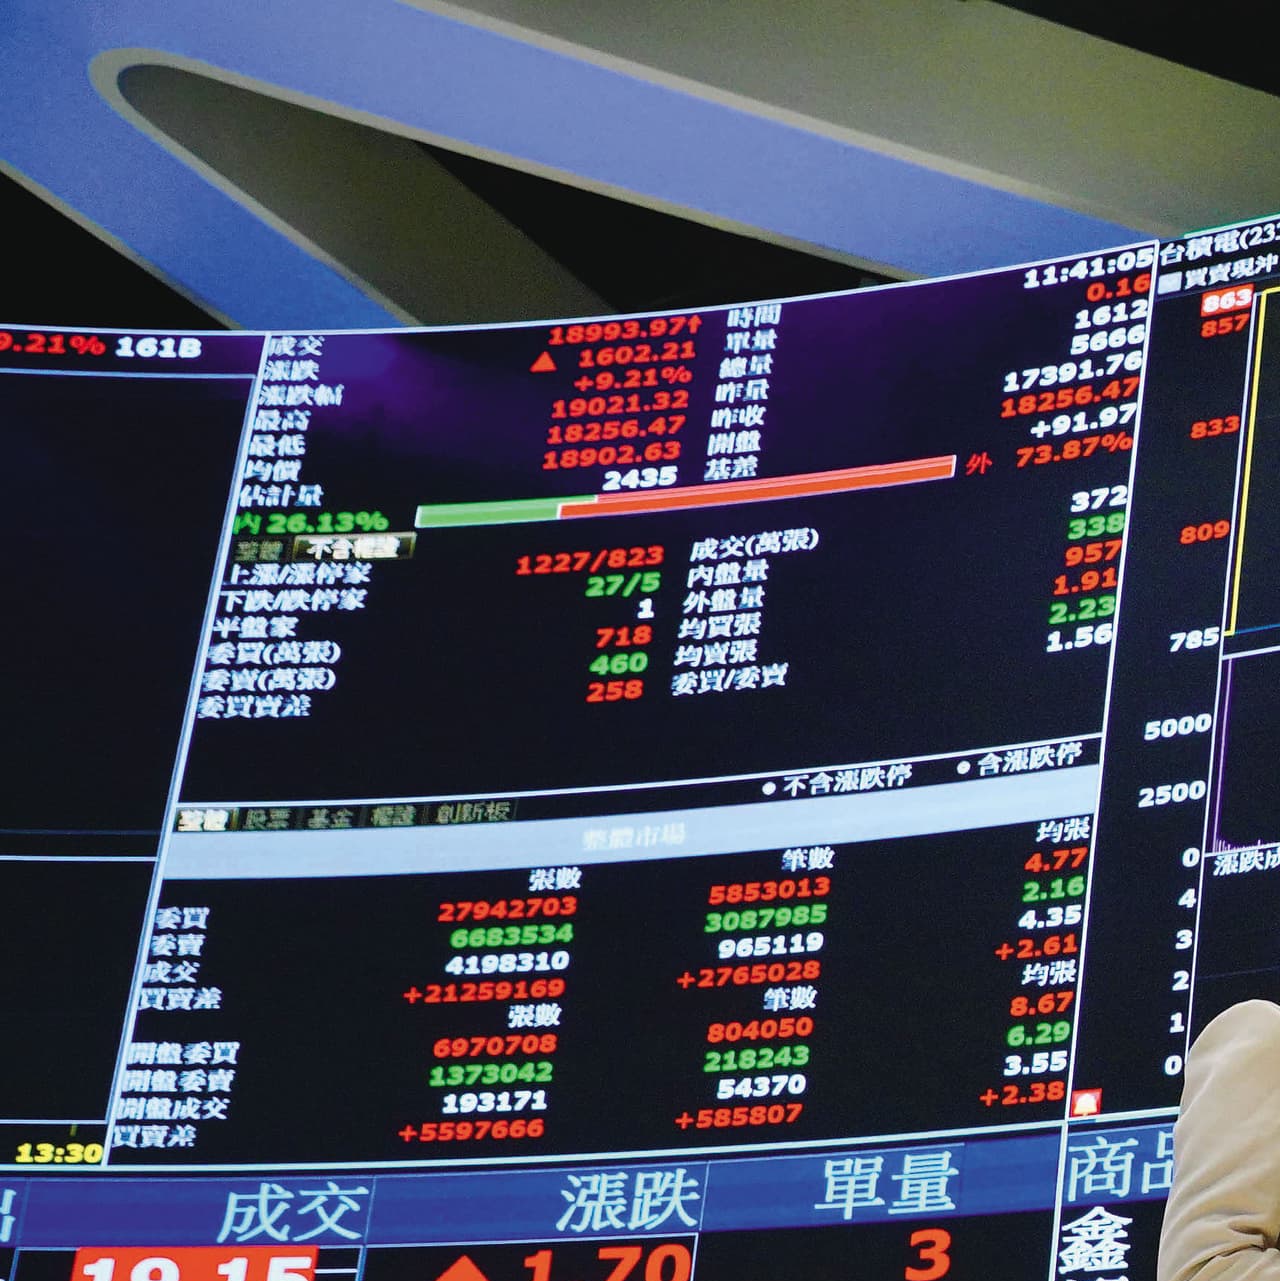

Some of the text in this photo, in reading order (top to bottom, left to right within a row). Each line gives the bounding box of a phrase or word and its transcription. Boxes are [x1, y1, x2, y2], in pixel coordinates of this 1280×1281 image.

[1023, 247, 1154, 288] 11:41:05
[1203, 289, 1252, 312] 863
[725, 304, 781, 329] 時間
[1073, 300, 1147, 329] 1612
[579, 341, 695, 367] 1602.21
[575, 366, 692, 391] +9.21%
[1003, 350, 1142, 392] 17391.76
[552, 390, 688, 418] 19021.32
[1191, 416, 1239, 438] 833
[1017, 432, 1133, 467] 73.87%
[1070, 485, 1128, 511] 372
[267, 512, 388, 537] 26.13%
[690, 528, 818, 561] 成交(萬張)
[1066, 539, 1122, 566] 957
[517, 546, 663, 574] 1227/823
[586, 572, 660, 597] 27/5
[1144, 714, 1212, 740] 5000
[977, 741, 1083, 776] 含漲跌停
[782, 763, 912, 798] 不含漲跌停
[1138, 780, 1206, 807] 2500
[1036, 817, 1090, 843] 均張
[1025, 847, 1087, 872] 4.77
[709, 877, 830, 904] 5853013
[438, 896, 576, 921] 27942703
[1018, 904, 1081, 929] 4.35
[719, 932, 823, 958] 965119
[445, 951, 569, 975] 4198310
[708, 1017, 813, 1042] 804050
[16, 1144, 103, 1162] 13:30
[815, 1151, 959, 1219] 單量
[217, 1182, 369, 1242] 成交
[550, 1167, 703, 1232] 漲跌
[1059, 1206, 1132, 1274] 鑫
[905, 1229, 950, 1281] 3
